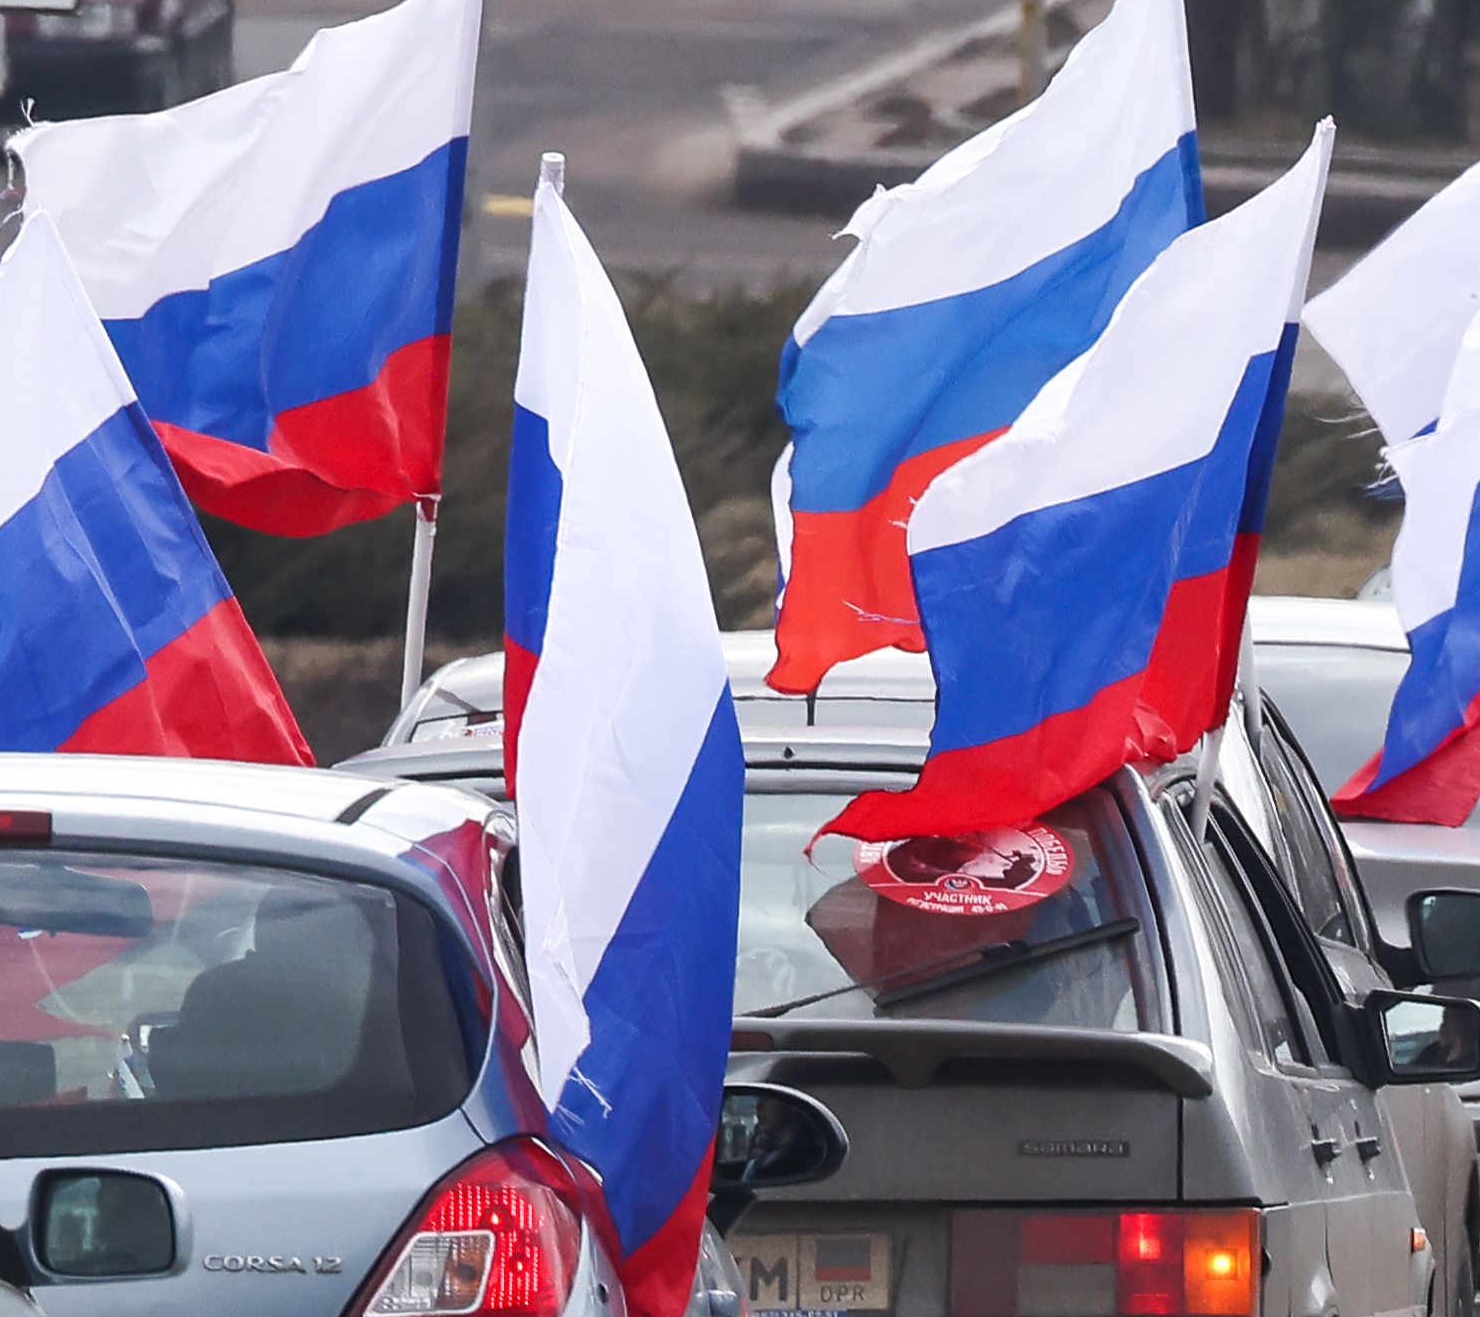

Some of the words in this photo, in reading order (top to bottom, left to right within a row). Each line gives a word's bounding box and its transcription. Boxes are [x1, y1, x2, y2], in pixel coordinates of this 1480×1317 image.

[203, 1253, 307, 1274] CORSA
[737, 1256, 789, 1302] M
[820, 1285, 866, 1302] DPR
